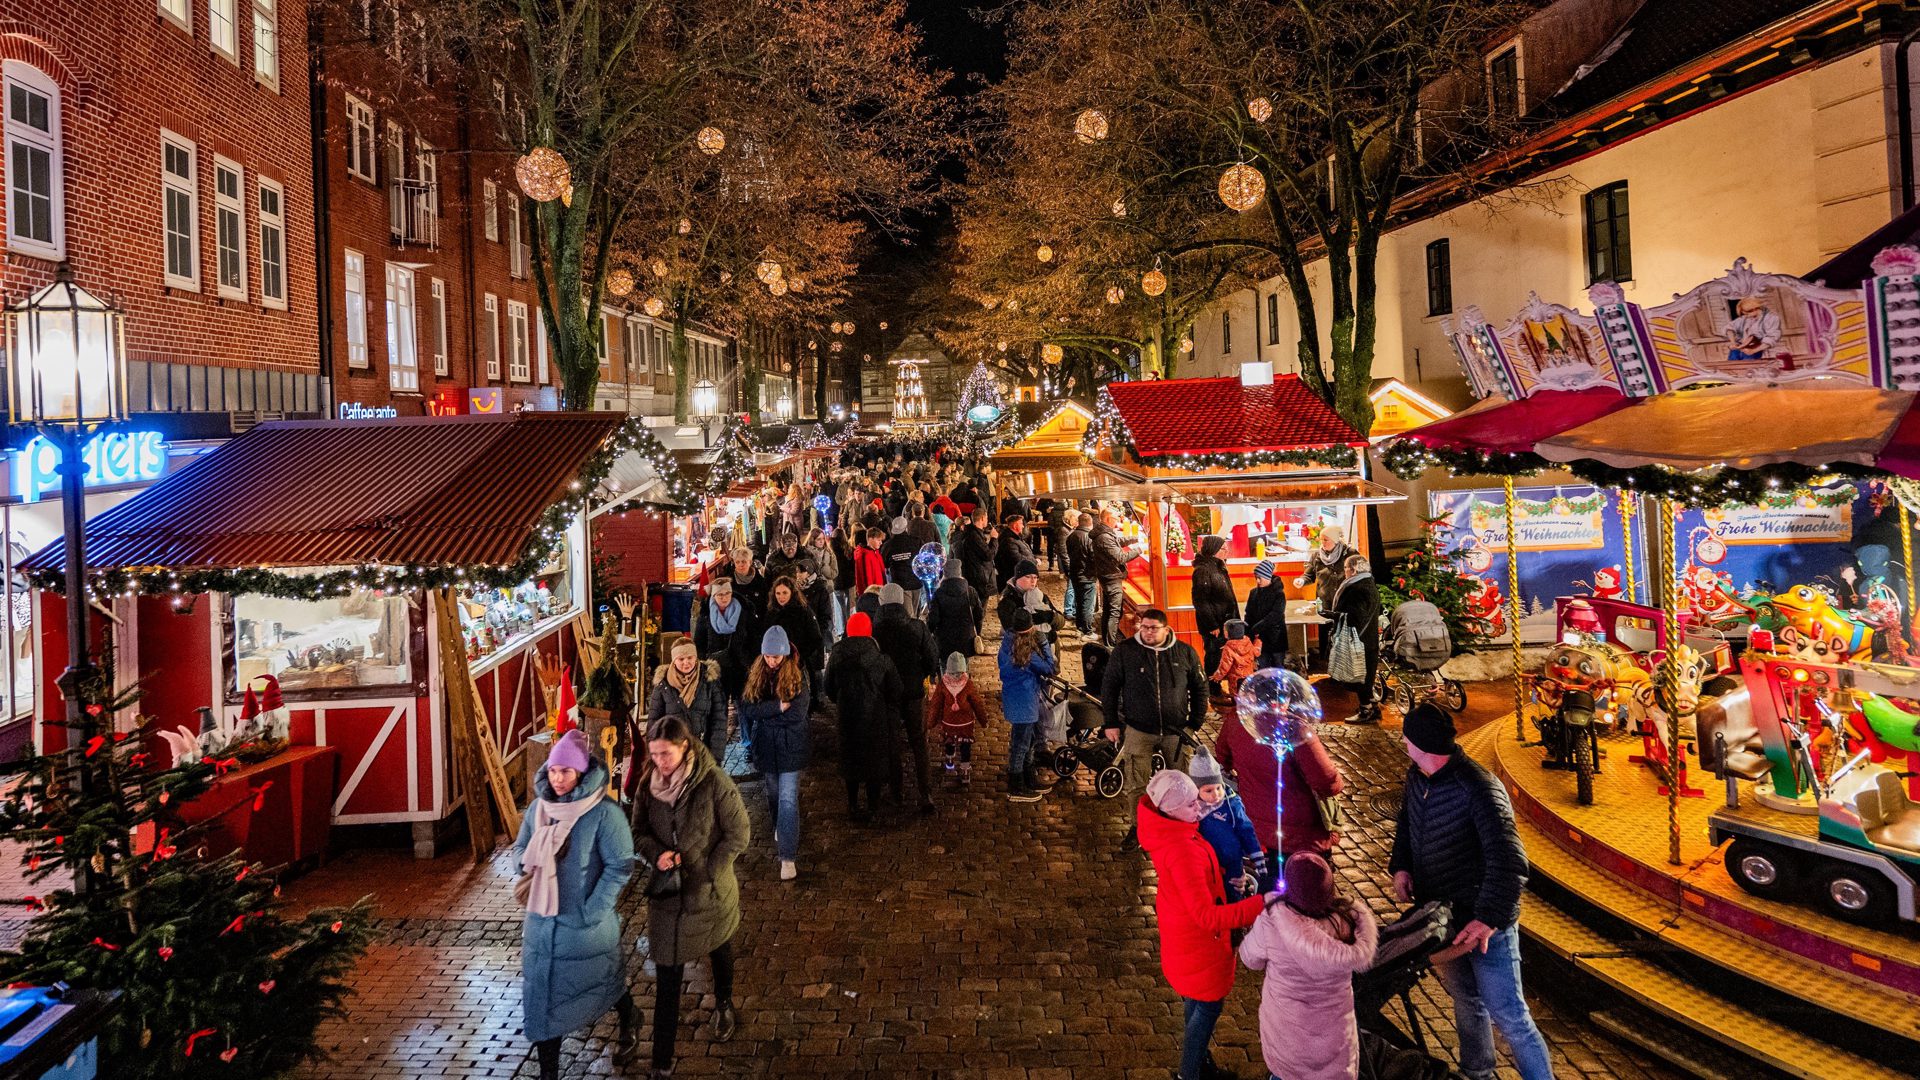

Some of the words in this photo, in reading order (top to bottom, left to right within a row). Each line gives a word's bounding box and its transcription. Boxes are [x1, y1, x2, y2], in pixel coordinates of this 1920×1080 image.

[1483, 529, 1518, 543] Froe
[1521, 526, 1600, 541] Weihnachten
[1716, 521, 1757, 536] Frohe
[1759, 519, 1848, 534] Weihnachten
